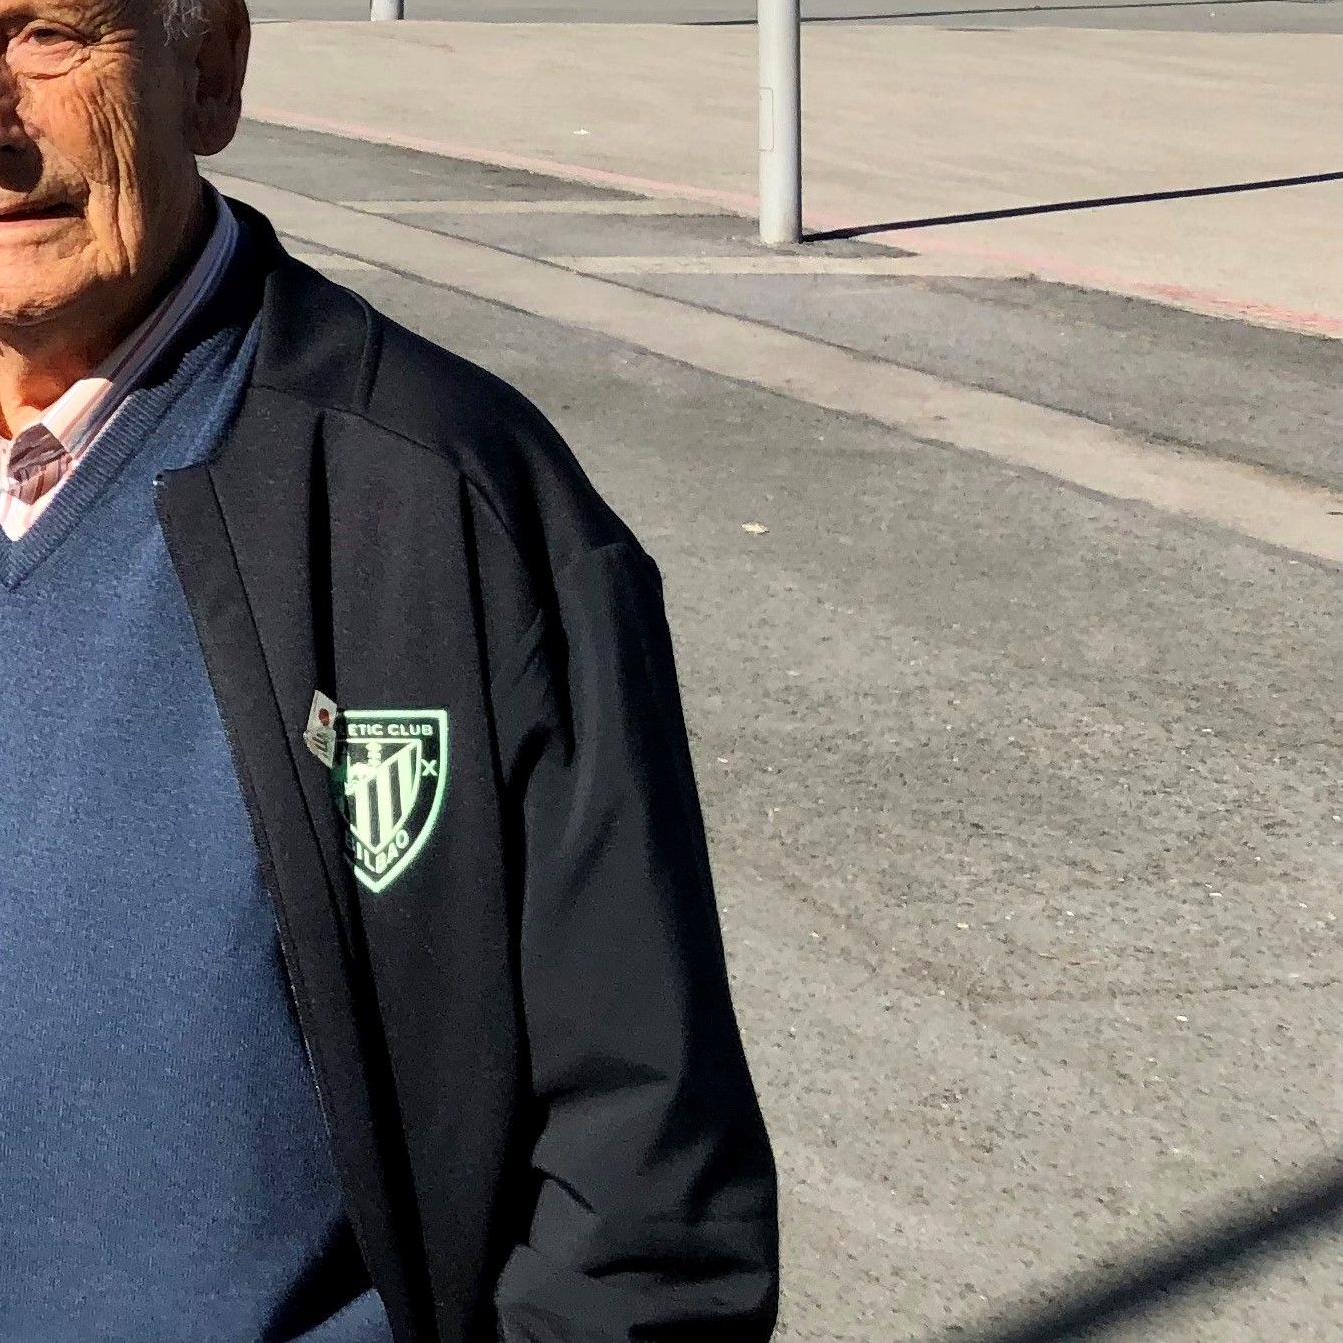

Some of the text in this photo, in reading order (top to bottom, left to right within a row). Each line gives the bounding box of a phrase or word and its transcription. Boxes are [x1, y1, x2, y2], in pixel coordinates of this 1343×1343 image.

[347, 723, 433, 737] ETIC CLUB
[354, 829, 410, 875] ILBAO
